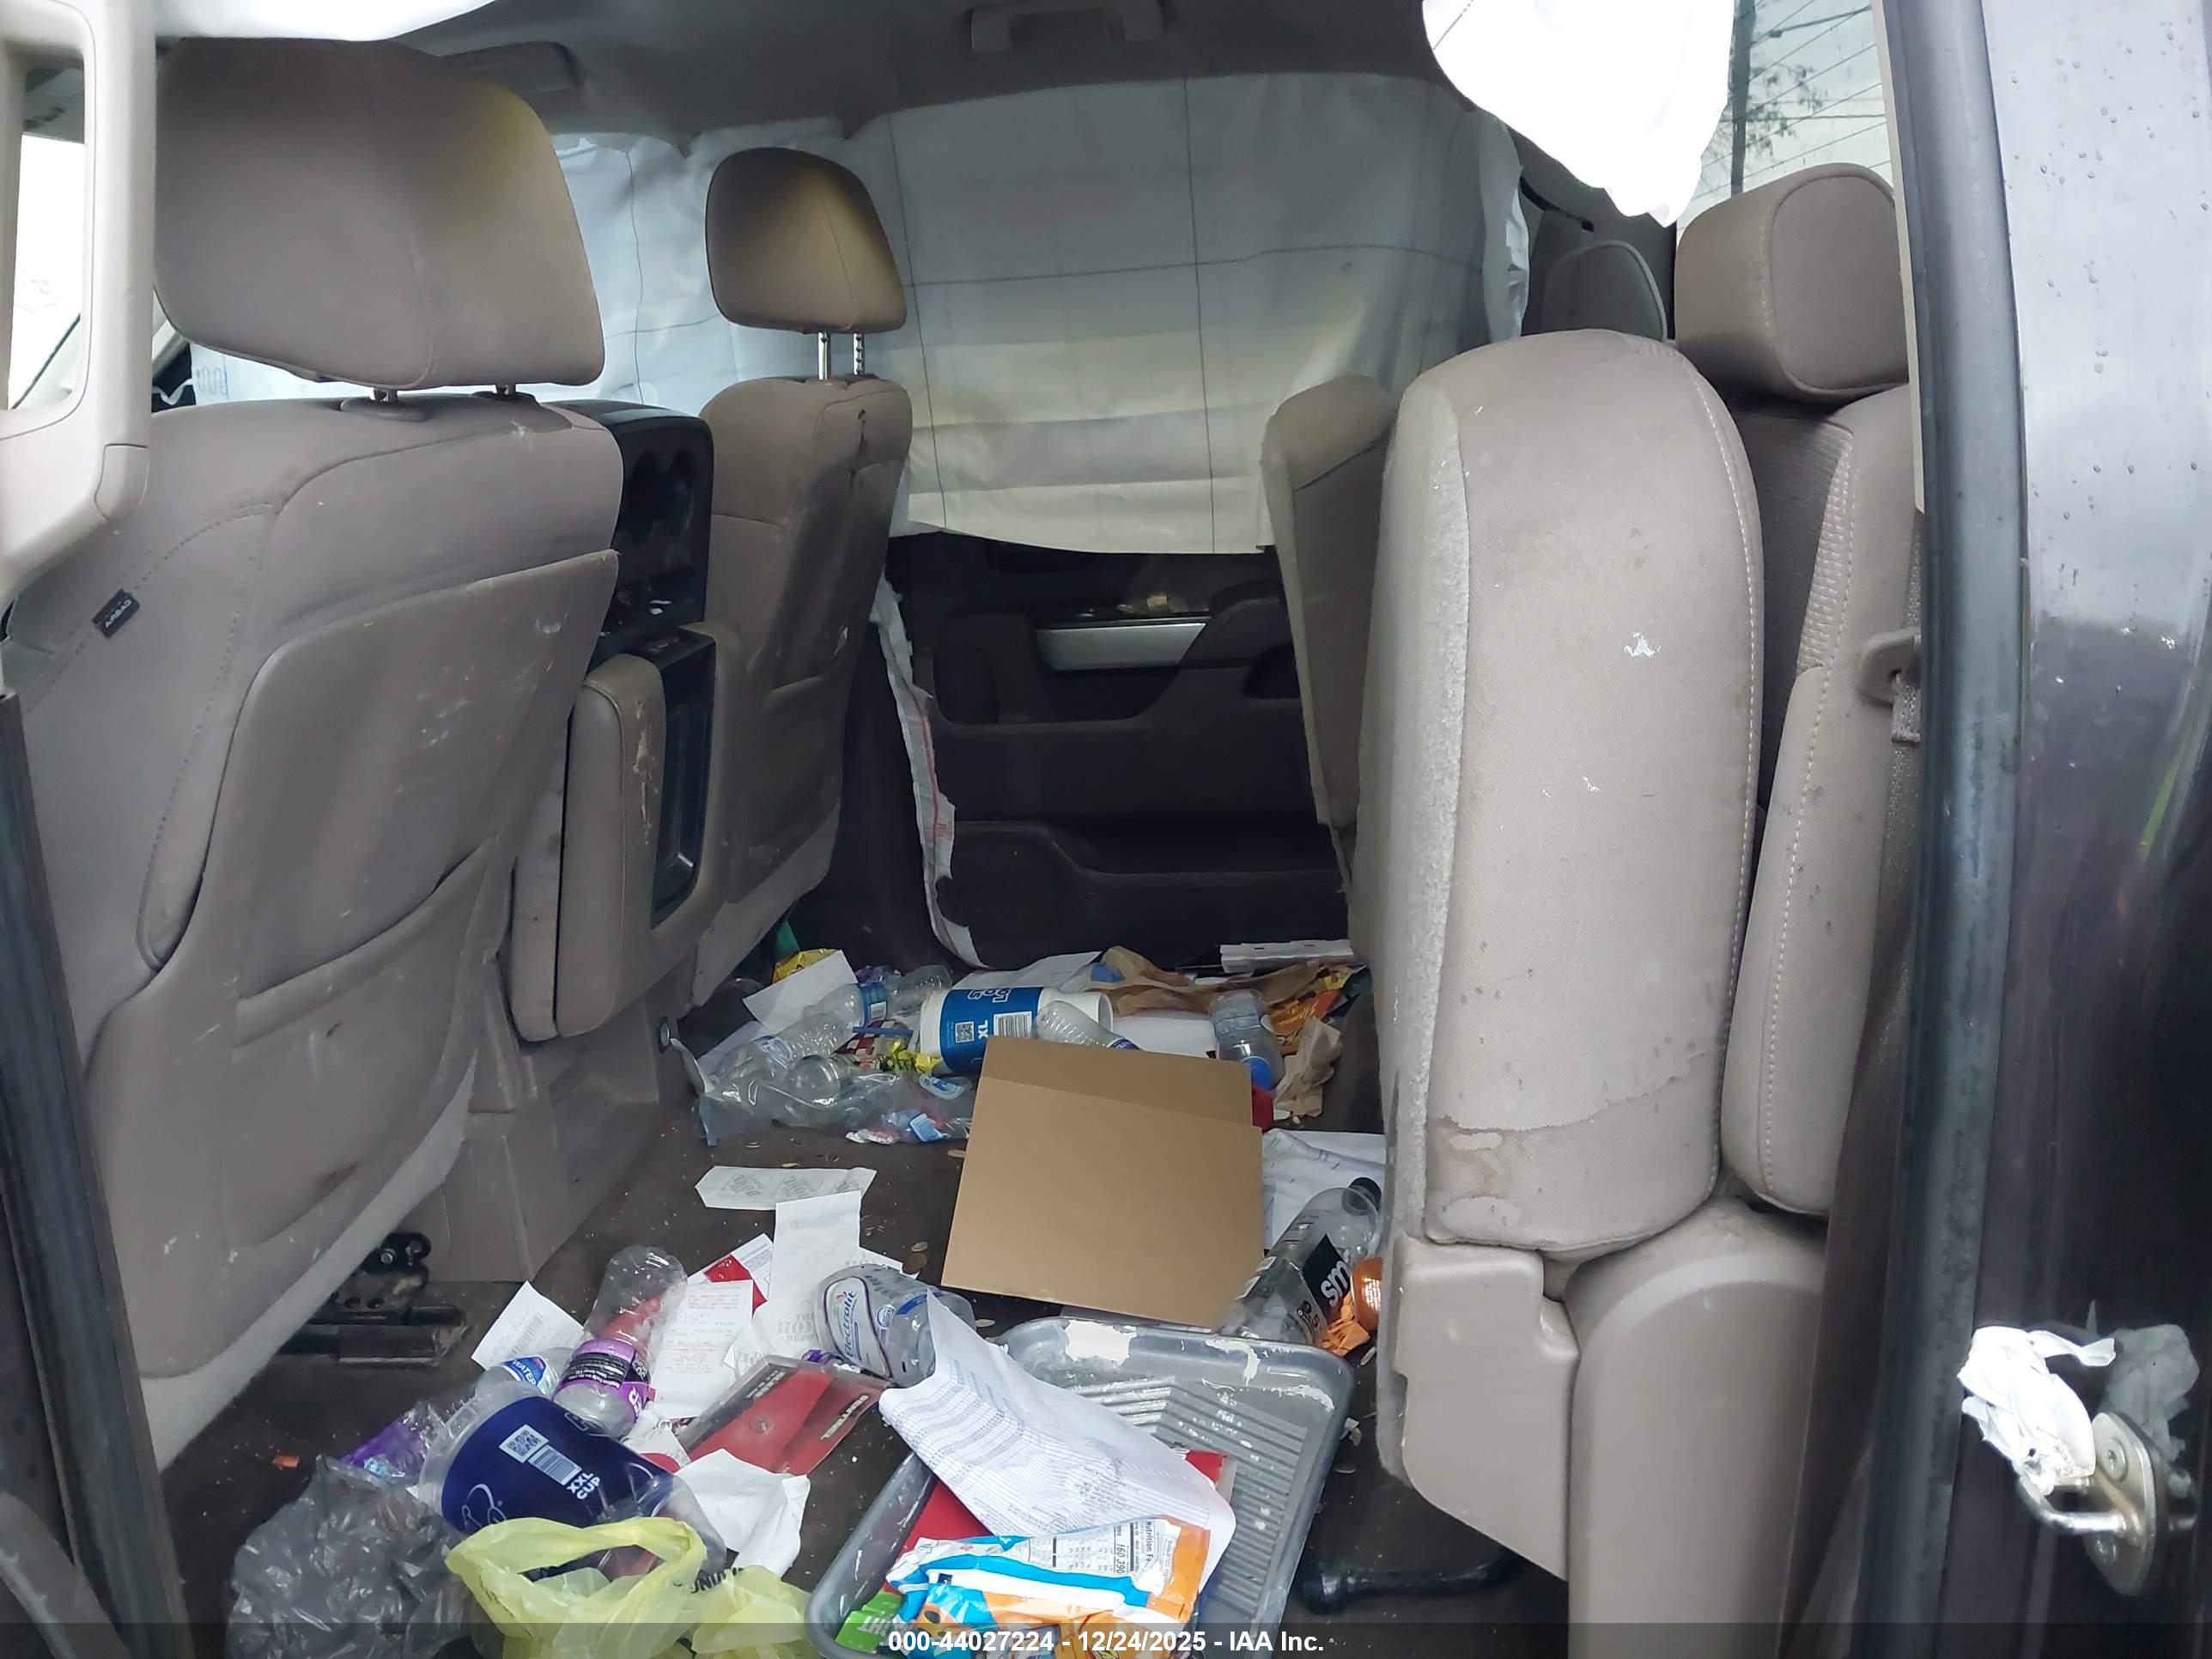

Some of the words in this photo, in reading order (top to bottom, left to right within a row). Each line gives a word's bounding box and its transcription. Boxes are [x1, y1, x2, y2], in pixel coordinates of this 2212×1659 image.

[977, 1019, 988, 1040] XL
[842, 1291, 859, 1358] Electrolit
[512, 1358, 538, 1386] WATER
[567, 1471, 594, 1494] XXL
[576, 1476, 601, 1501] CUP
